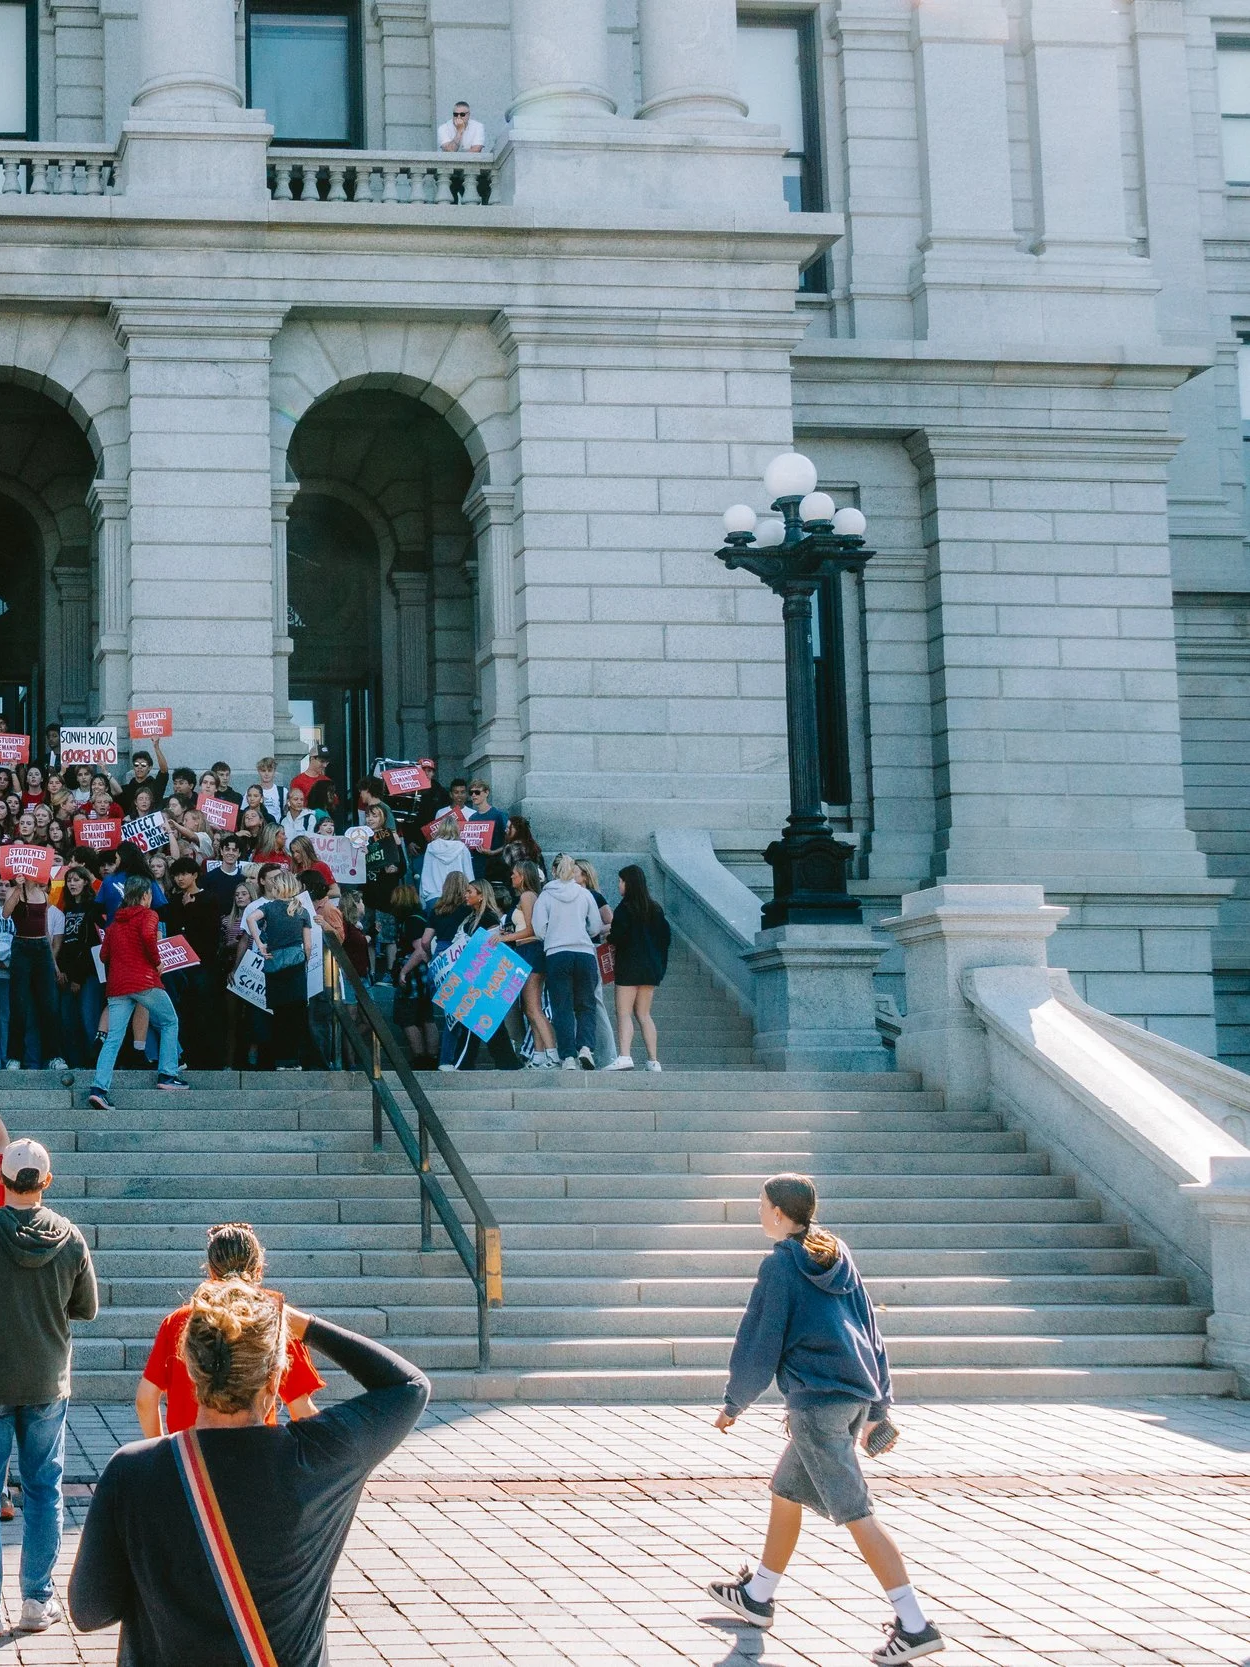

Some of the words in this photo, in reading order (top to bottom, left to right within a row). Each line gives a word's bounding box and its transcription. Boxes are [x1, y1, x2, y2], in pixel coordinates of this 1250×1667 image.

[138, 712, 166, 721] STUDENTS
[135, 720, 158, 728] DEMAND
[143, 727, 163, 735] ACTION
[60, 730, 86, 745] HANDS
[88, 731, 115, 746] YOUR
[2, 752, 21, 760] ACTION
[92, 748, 116, 763] OUR
[392, 769, 418, 778] STUDENTS
[202, 806, 222, 817] DEMAND
[205, 799, 232, 813] STUDENTS
[122, 814, 156, 838] ROTECT
[207, 814, 226, 827] ACTION
[83, 823, 114, 831] STUDENTS
[145, 826, 162, 838] NOT
[464, 824, 488, 832] STUDENTS
[81, 832, 105, 840] DEMAND
[89, 840, 110, 848] ACTION
[10, 849, 45, 859] STUDENTS
[366, 849, 384, 862] UNS!
[5, 857, 32, 865] DEMAND
[14, 865, 38, 876] ACTION
[433, 972, 462, 1009] HOW
[464, 935, 498, 983] MANY
[453, 985, 482, 1022] KIDS
[483, 956, 514, 999] HAVE
[474, 1015, 492, 1036] TO
[502, 967, 528, 1003] DIE?
